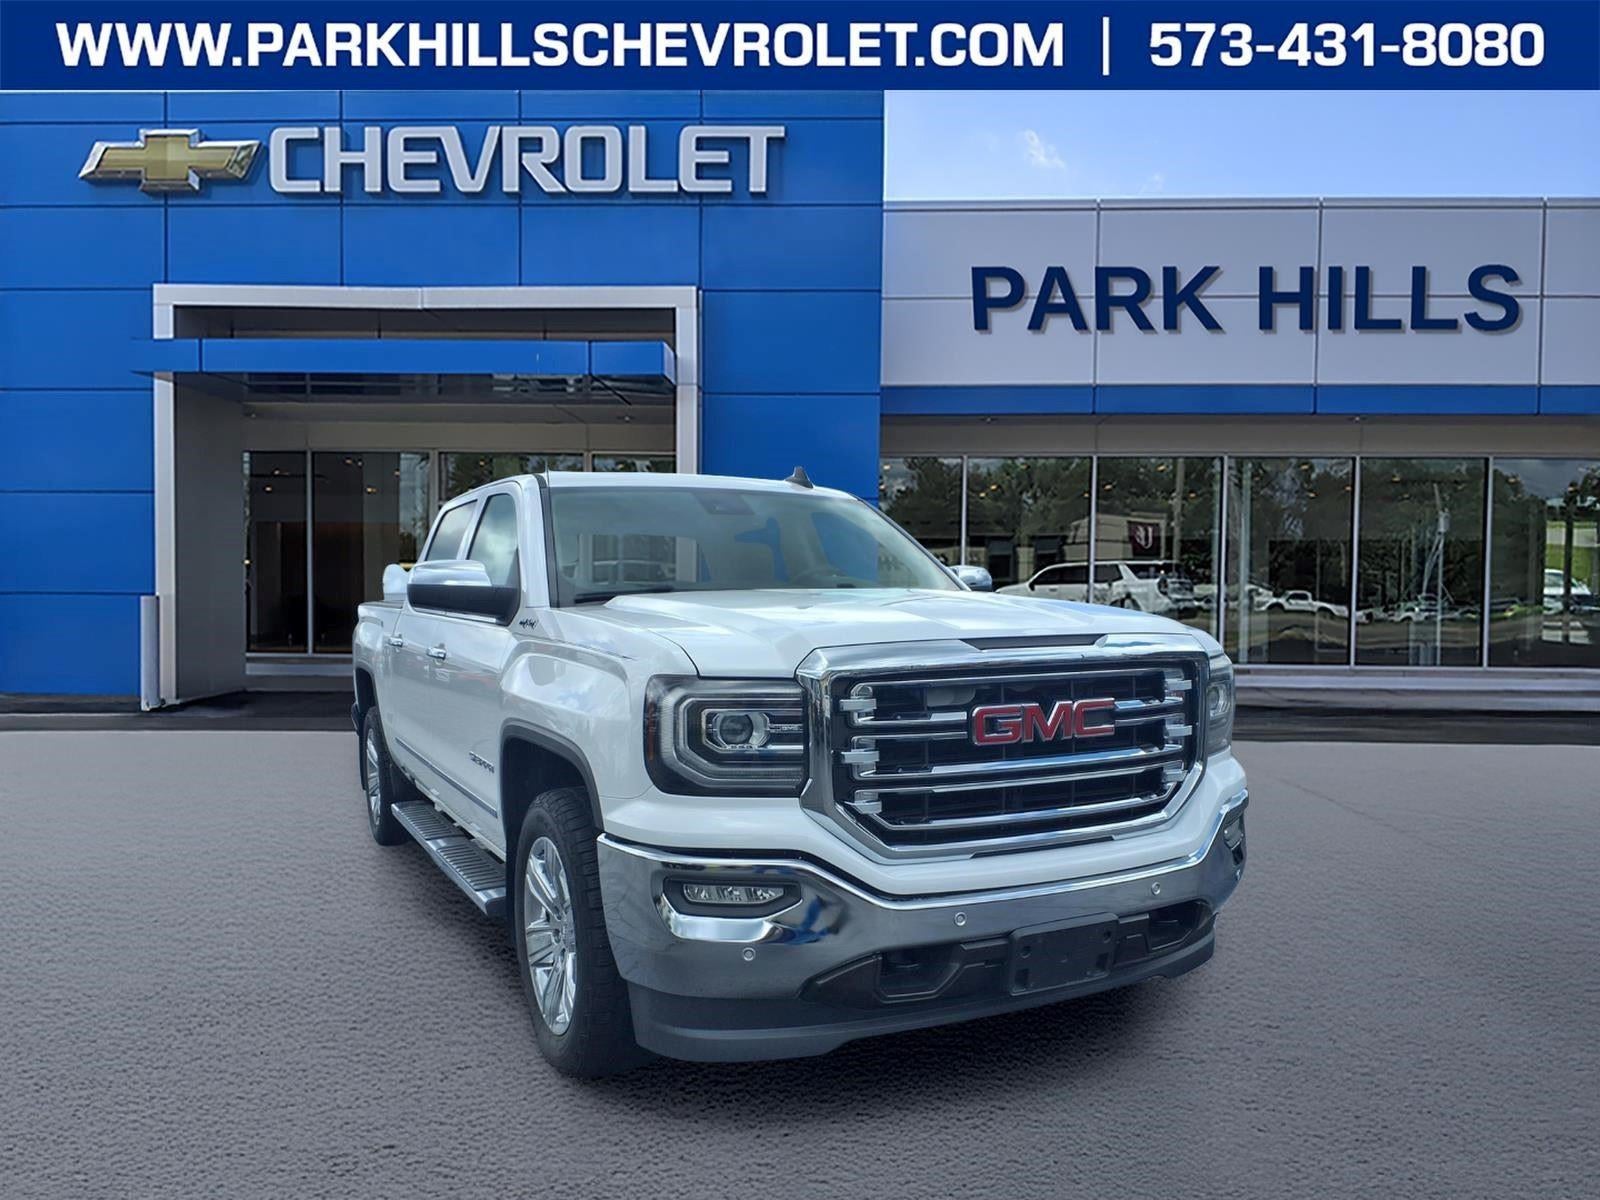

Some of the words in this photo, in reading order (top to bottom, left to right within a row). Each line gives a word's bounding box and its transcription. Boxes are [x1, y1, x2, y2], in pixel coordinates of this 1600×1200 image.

[269, 125, 786, 194] CHEVROLET
[971, 265, 1223, 332] PARK
[1258, 264, 1522, 332] HILLS
[971, 697, 1116, 747] GMC
